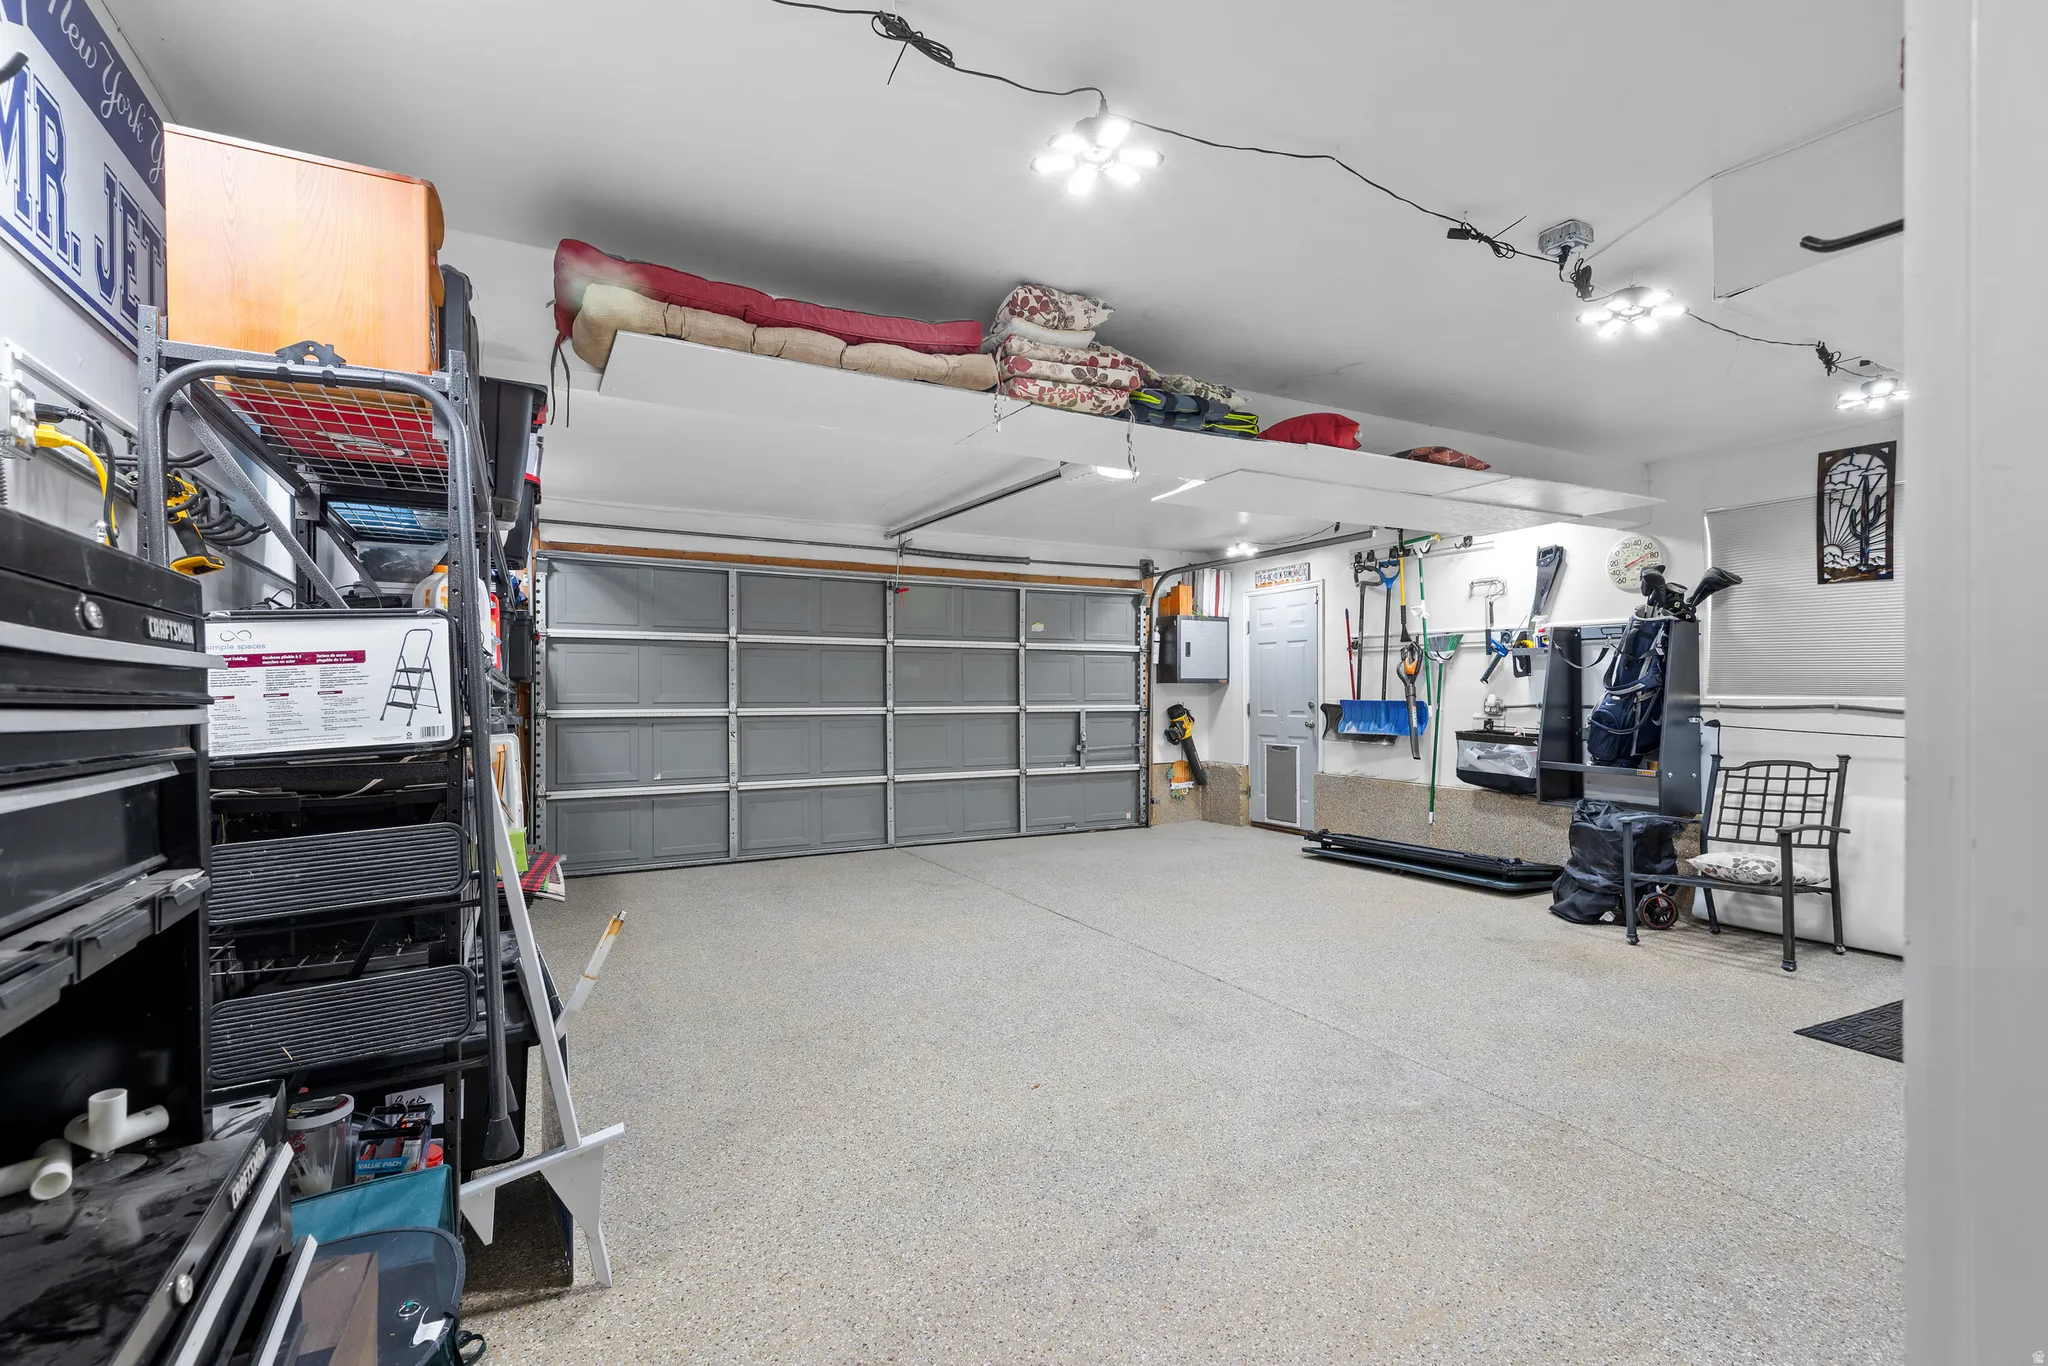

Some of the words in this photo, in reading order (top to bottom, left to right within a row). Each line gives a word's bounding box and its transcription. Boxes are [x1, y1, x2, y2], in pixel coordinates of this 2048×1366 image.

[100, 41, 146, 142] York
[95, 161, 168, 331] JET
[1644, 542, 1652, 550] 60
[148, 616, 195, 644] CRAFTSMAN
[206, 643, 235, 652] simple
[237, 643, 266, 652] spaces
[231, 1137, 267, 1210] CRAFTSMAN
[358, 1162, 381, 1170] VALUE
[382, 1160, 402, 1168] PACK
